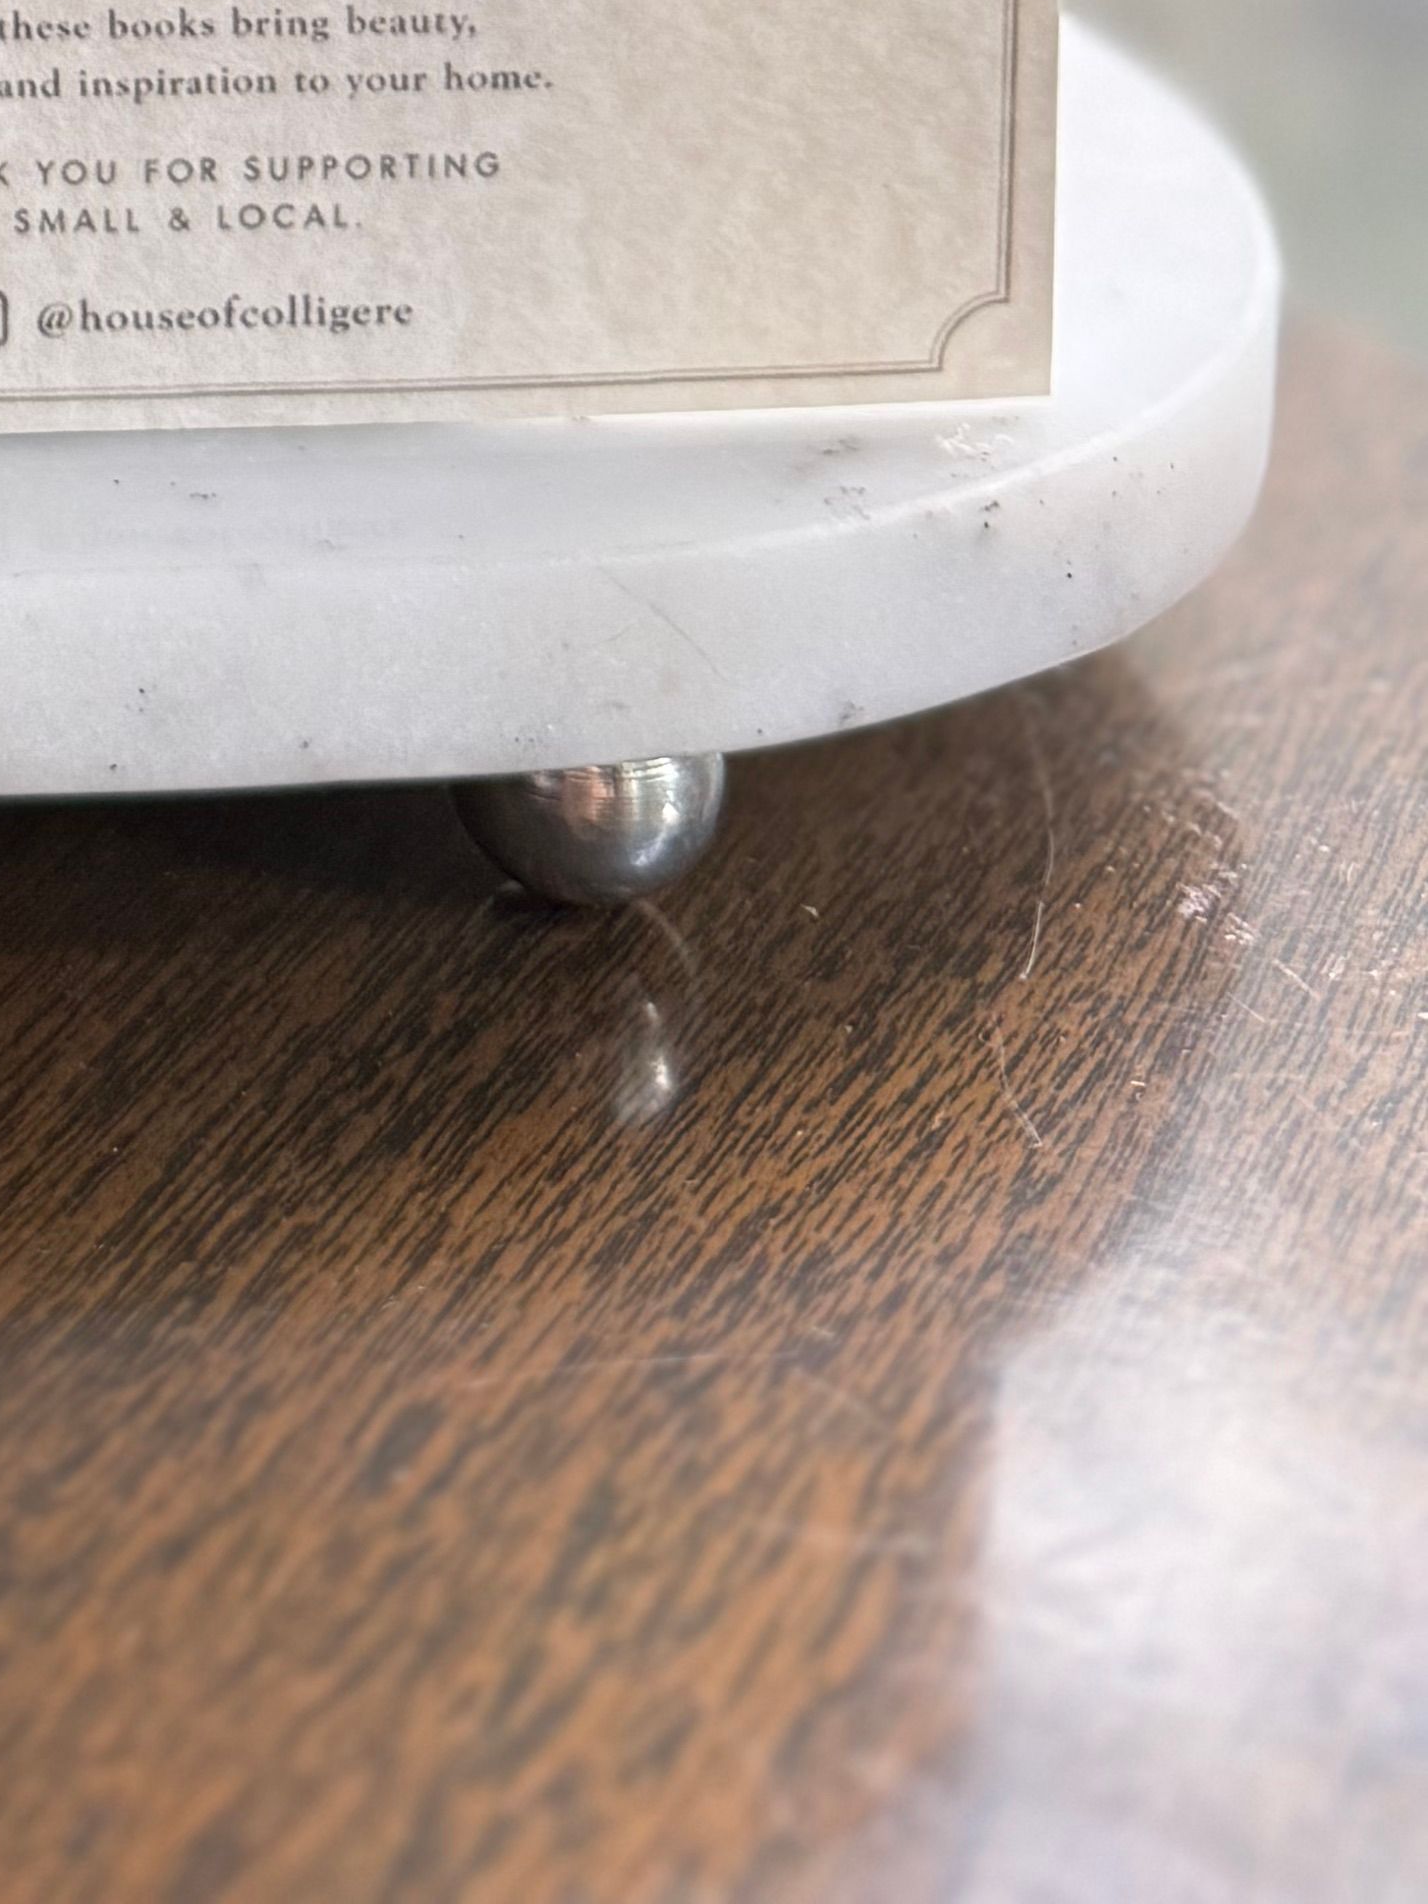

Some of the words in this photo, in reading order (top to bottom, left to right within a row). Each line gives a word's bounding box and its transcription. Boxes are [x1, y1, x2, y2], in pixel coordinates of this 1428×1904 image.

[106, 5, 217, 42] books
[229, 4, 332, 45] bring
[344, 2, 479, 43] beauty,
[77, 65, 279, 108] inspiration
[292, 70, 333, 96] to
[344, 70, 430, 102] your
[442, 59, 555, 93] home.
[33, 157, 119, 189] YOU
[142, 154, 219, 189] FOR
[241, 149, 502, 185] SUPPORTING
[12, 206, 142, 238] SMALL
[166, 205, 193, 235] &
[214, 200, 364, 234] LOCAL.
[34, 291, 415, 341] @houseofcolligere
